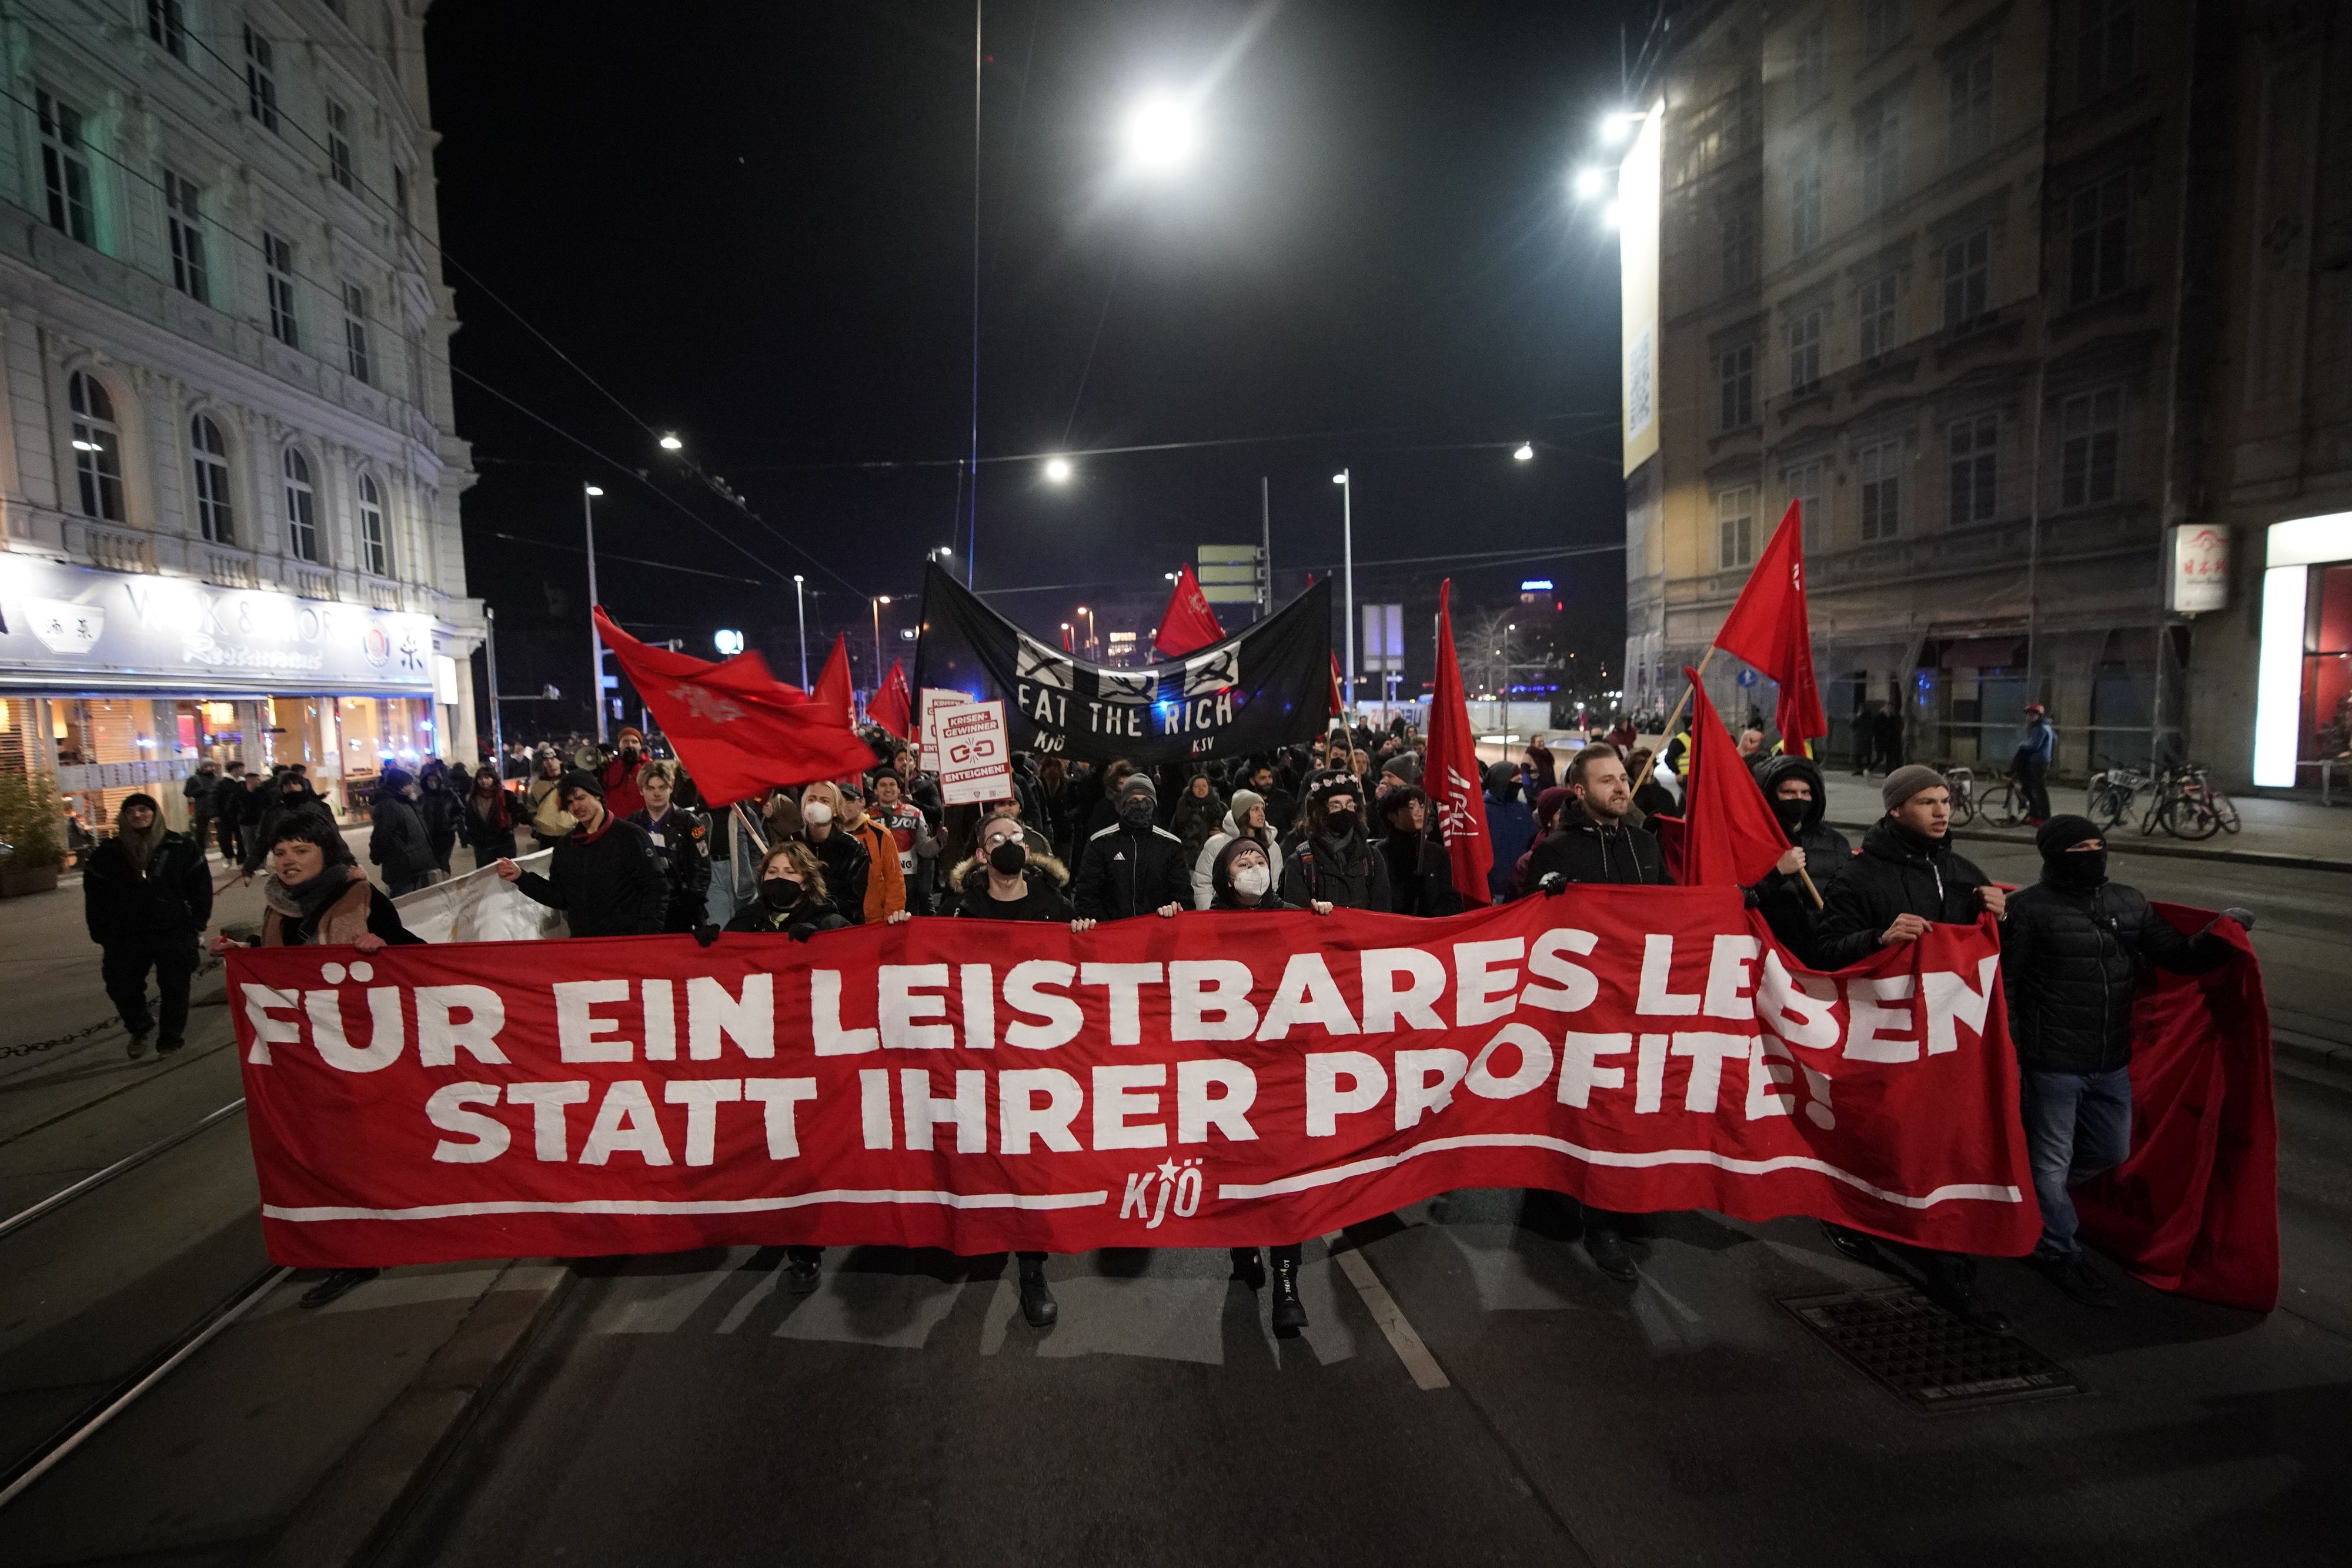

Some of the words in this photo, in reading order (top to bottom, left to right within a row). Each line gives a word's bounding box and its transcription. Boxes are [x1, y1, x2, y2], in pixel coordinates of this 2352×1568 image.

[125, 583, 229, 635] WK
[950, 713, 988, 727] KRISEN-
[1018, 684, 1069, 727] EAT
[1089, 703, 1142, 737] THE
[1164, 692, 1232, 735] RICH
[945, 721, 997, 737] GEWINNER
[1192, 736, 1214, 753] KSV
[945, 764, 1005, 783] ENTEIGNEN!
[240, 961, 512, 1073] FÜR
[552, 973, 775, 1063] EIN
[811, 928, 1599, 1057] LEISTBARES
[1635, 934, 1999, 1064] LEBEN
[426, 1077, 817, 1166] STATT
[859, 1059, 1259, 1154] IHRER
[1305, 1023, 1836, 1137] PROFITE!
